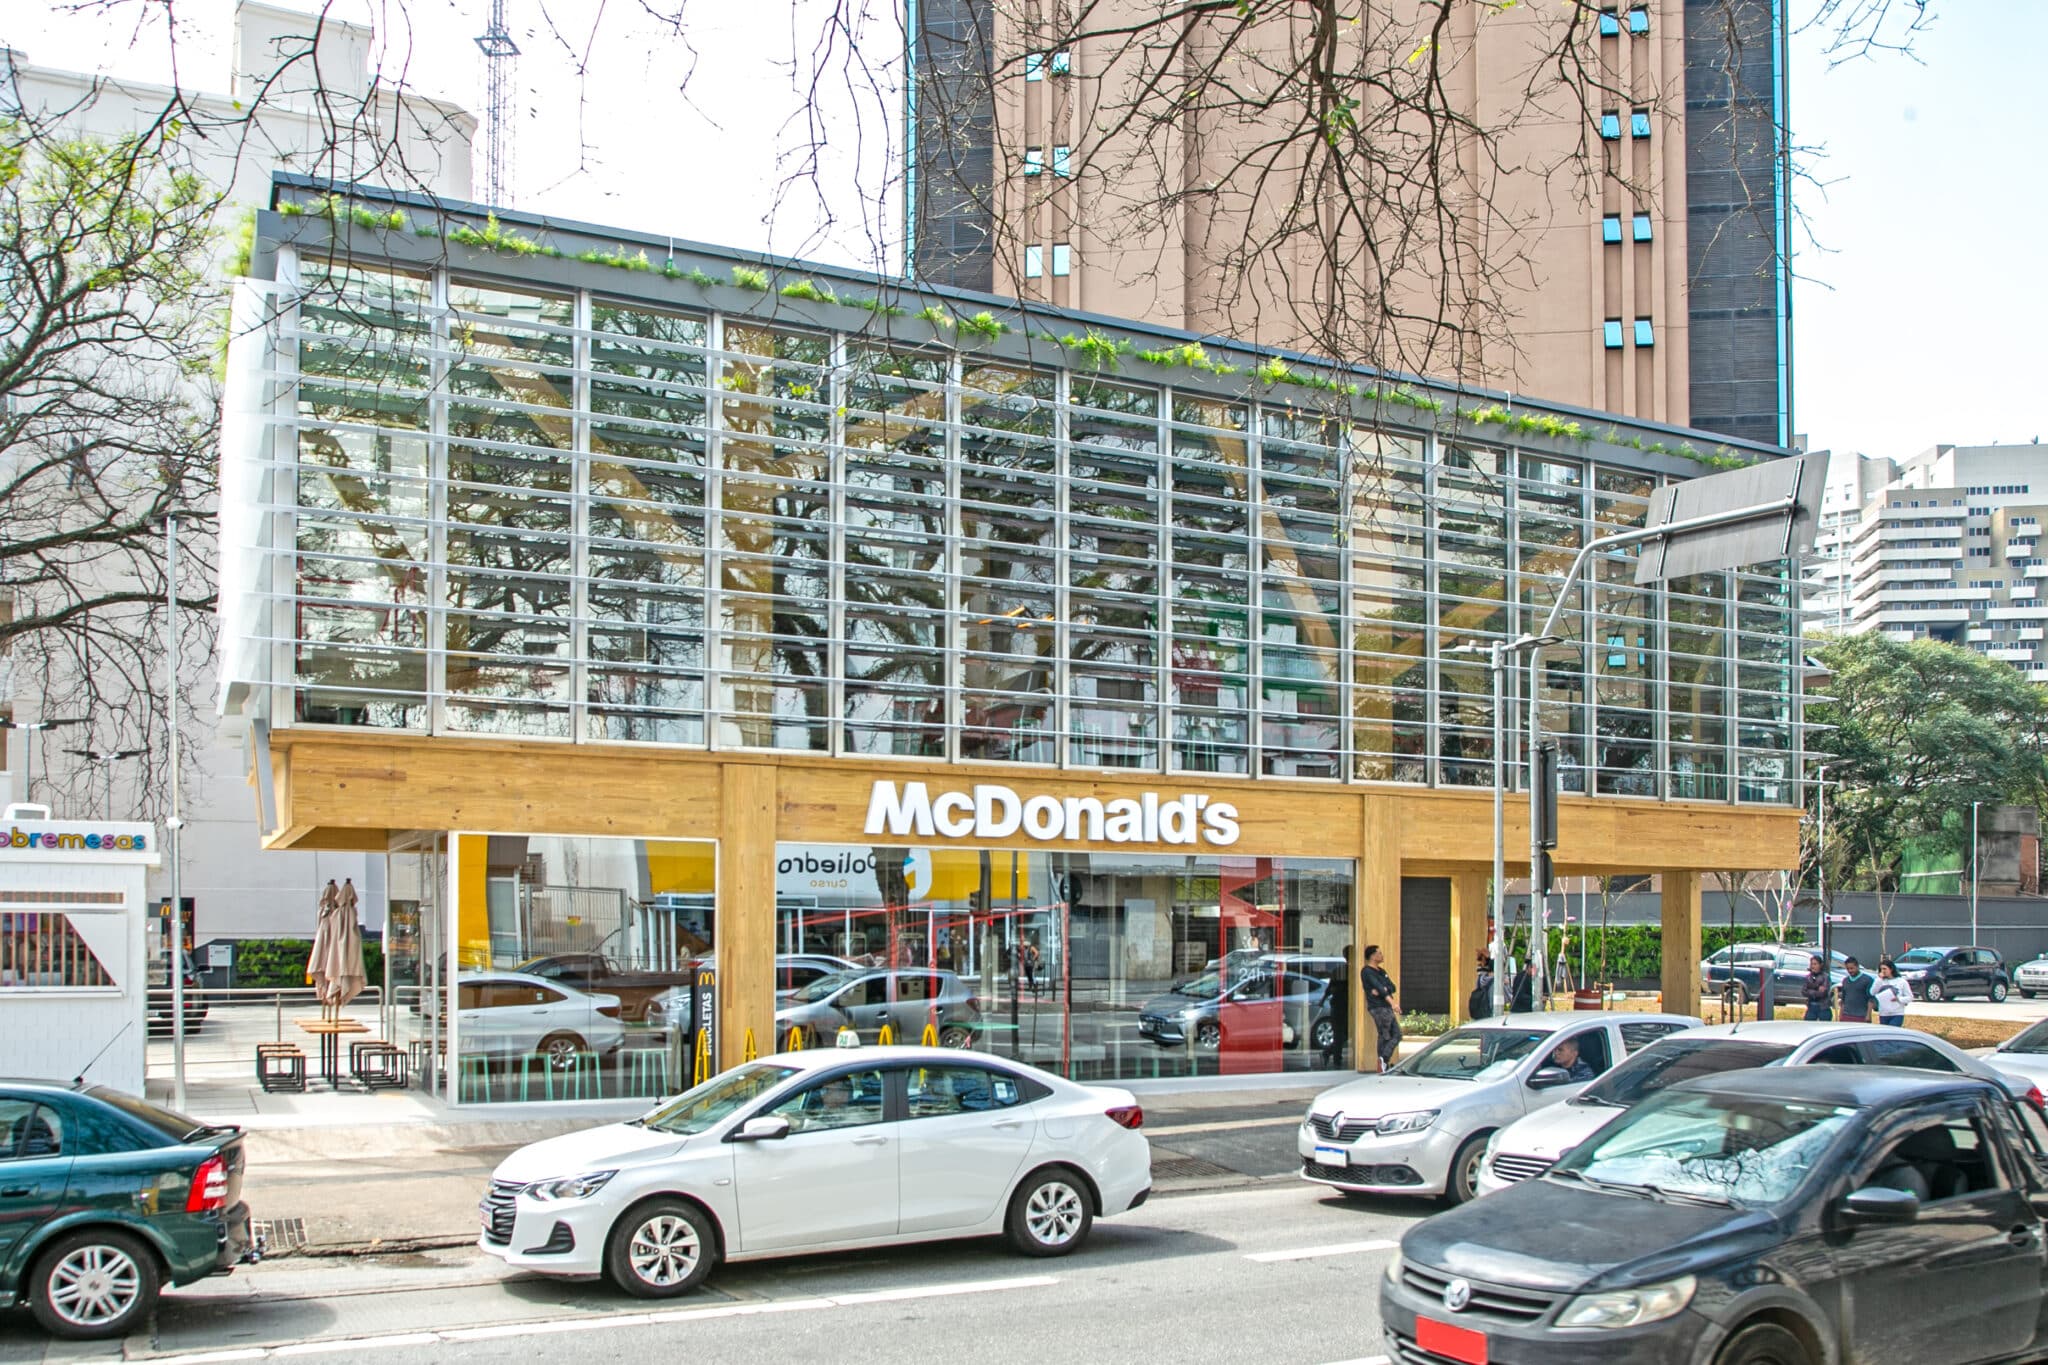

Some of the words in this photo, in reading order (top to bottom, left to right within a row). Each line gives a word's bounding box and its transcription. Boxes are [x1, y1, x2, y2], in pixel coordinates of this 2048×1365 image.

[863, 780, 1241, 846] McDonald's
[0, 826, 147, 850] obremesas
[1239, 967, 1266, 982] 24h
